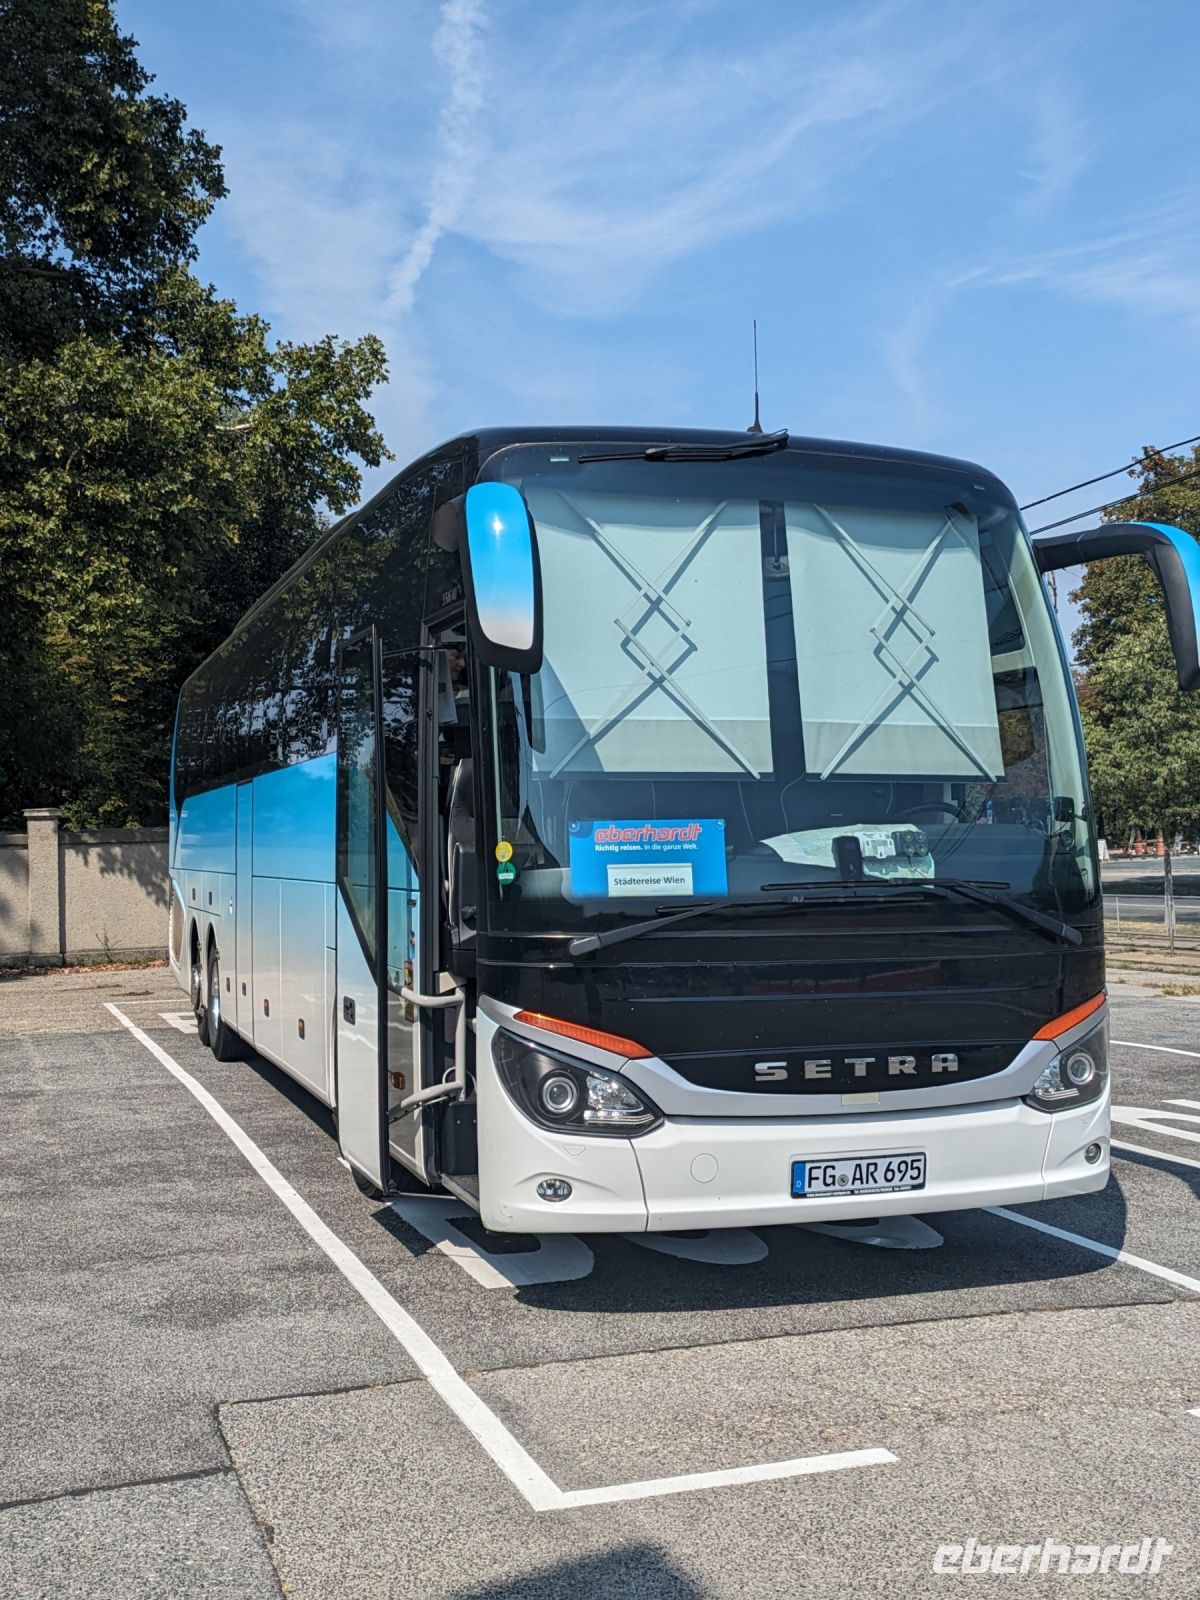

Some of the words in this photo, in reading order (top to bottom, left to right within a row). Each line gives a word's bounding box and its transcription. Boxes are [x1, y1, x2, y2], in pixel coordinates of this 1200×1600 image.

[595, 823, 702, 843] eberhardt
[595, 844, 619, 852] Richtig
[614, 877, 661, 886] Städtereise
[663, 876, 686, 884] Wien
[754, 1053, 959, 1081] SETRA
[883, 1158, 922, 1183] 695
